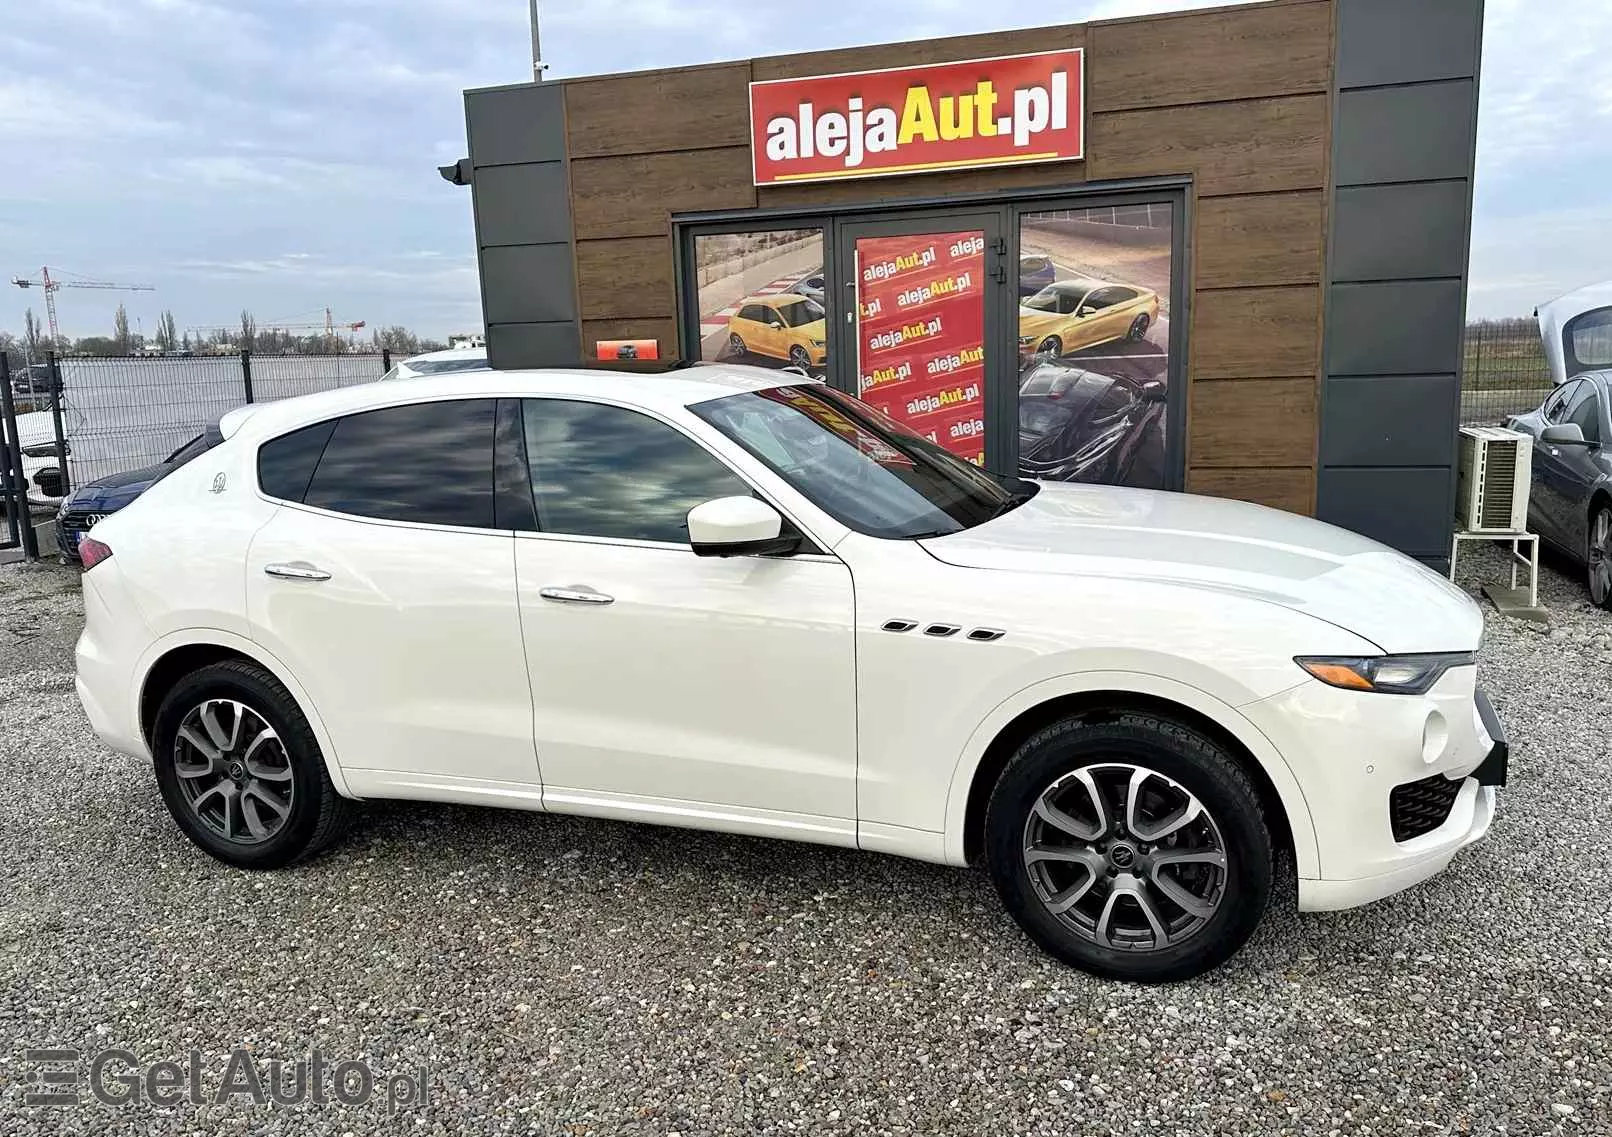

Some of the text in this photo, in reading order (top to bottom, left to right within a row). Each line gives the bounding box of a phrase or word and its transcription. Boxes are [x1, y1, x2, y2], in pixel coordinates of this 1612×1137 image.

[766, 71, 1068, 167] alejaAut.pl
[950, 237, 984, 257] aleja
[863, 246, 936, 281] alejaAut.pl
[897, 272, 971, 306] alejaAut.pl
[870, 317, 942, 349] alejaAut.pl
[907, 383, 980, 414] alejaAut.pl
[950, 419, 984, 437] aleja
